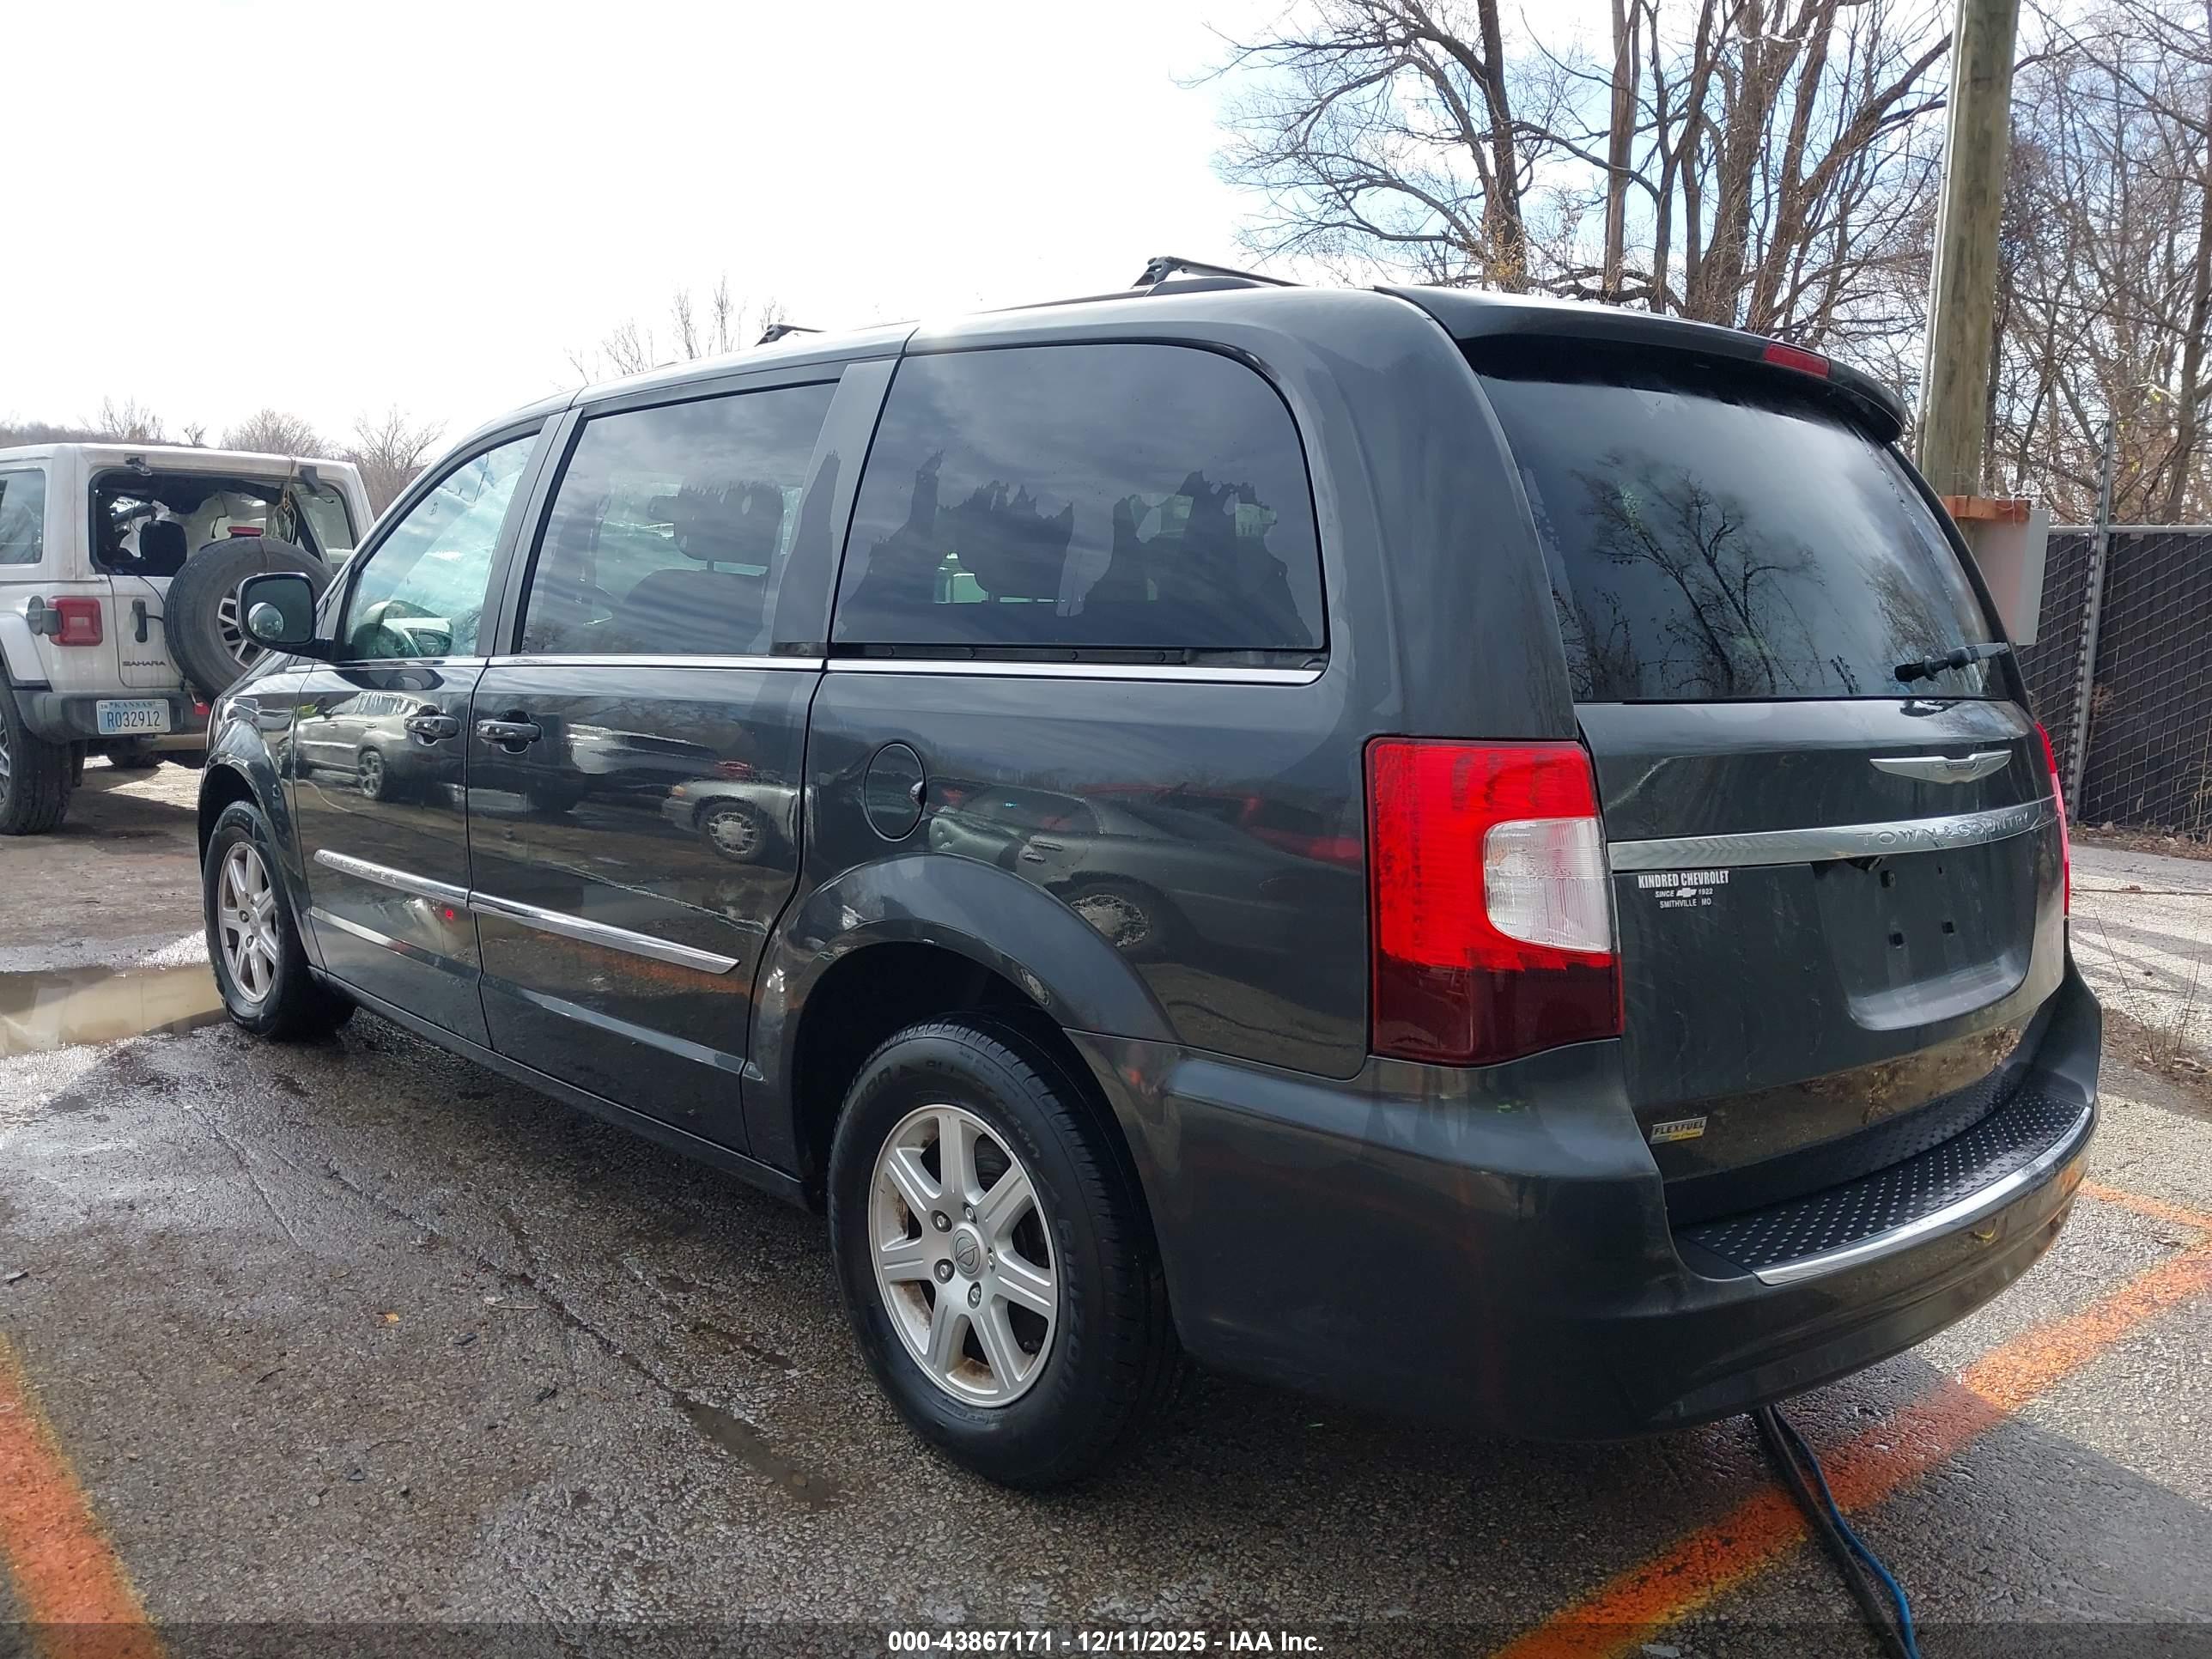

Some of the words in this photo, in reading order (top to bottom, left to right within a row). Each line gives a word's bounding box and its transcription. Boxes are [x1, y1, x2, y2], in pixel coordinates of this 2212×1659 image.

[1856, 828, 1938, 846] TOWN
[1957, 811, 2028, 838] COUNTRY
[1638, 873, 1679, 888] KINDRED
[1680, 871, 1729, 886] CHEVROLET
[1659, 898, 1697, 908] SMITHVILLE
[1701, 897, 1711, 906] MO
[1655, 1120, 1705, 1134] FLEXFUEL
